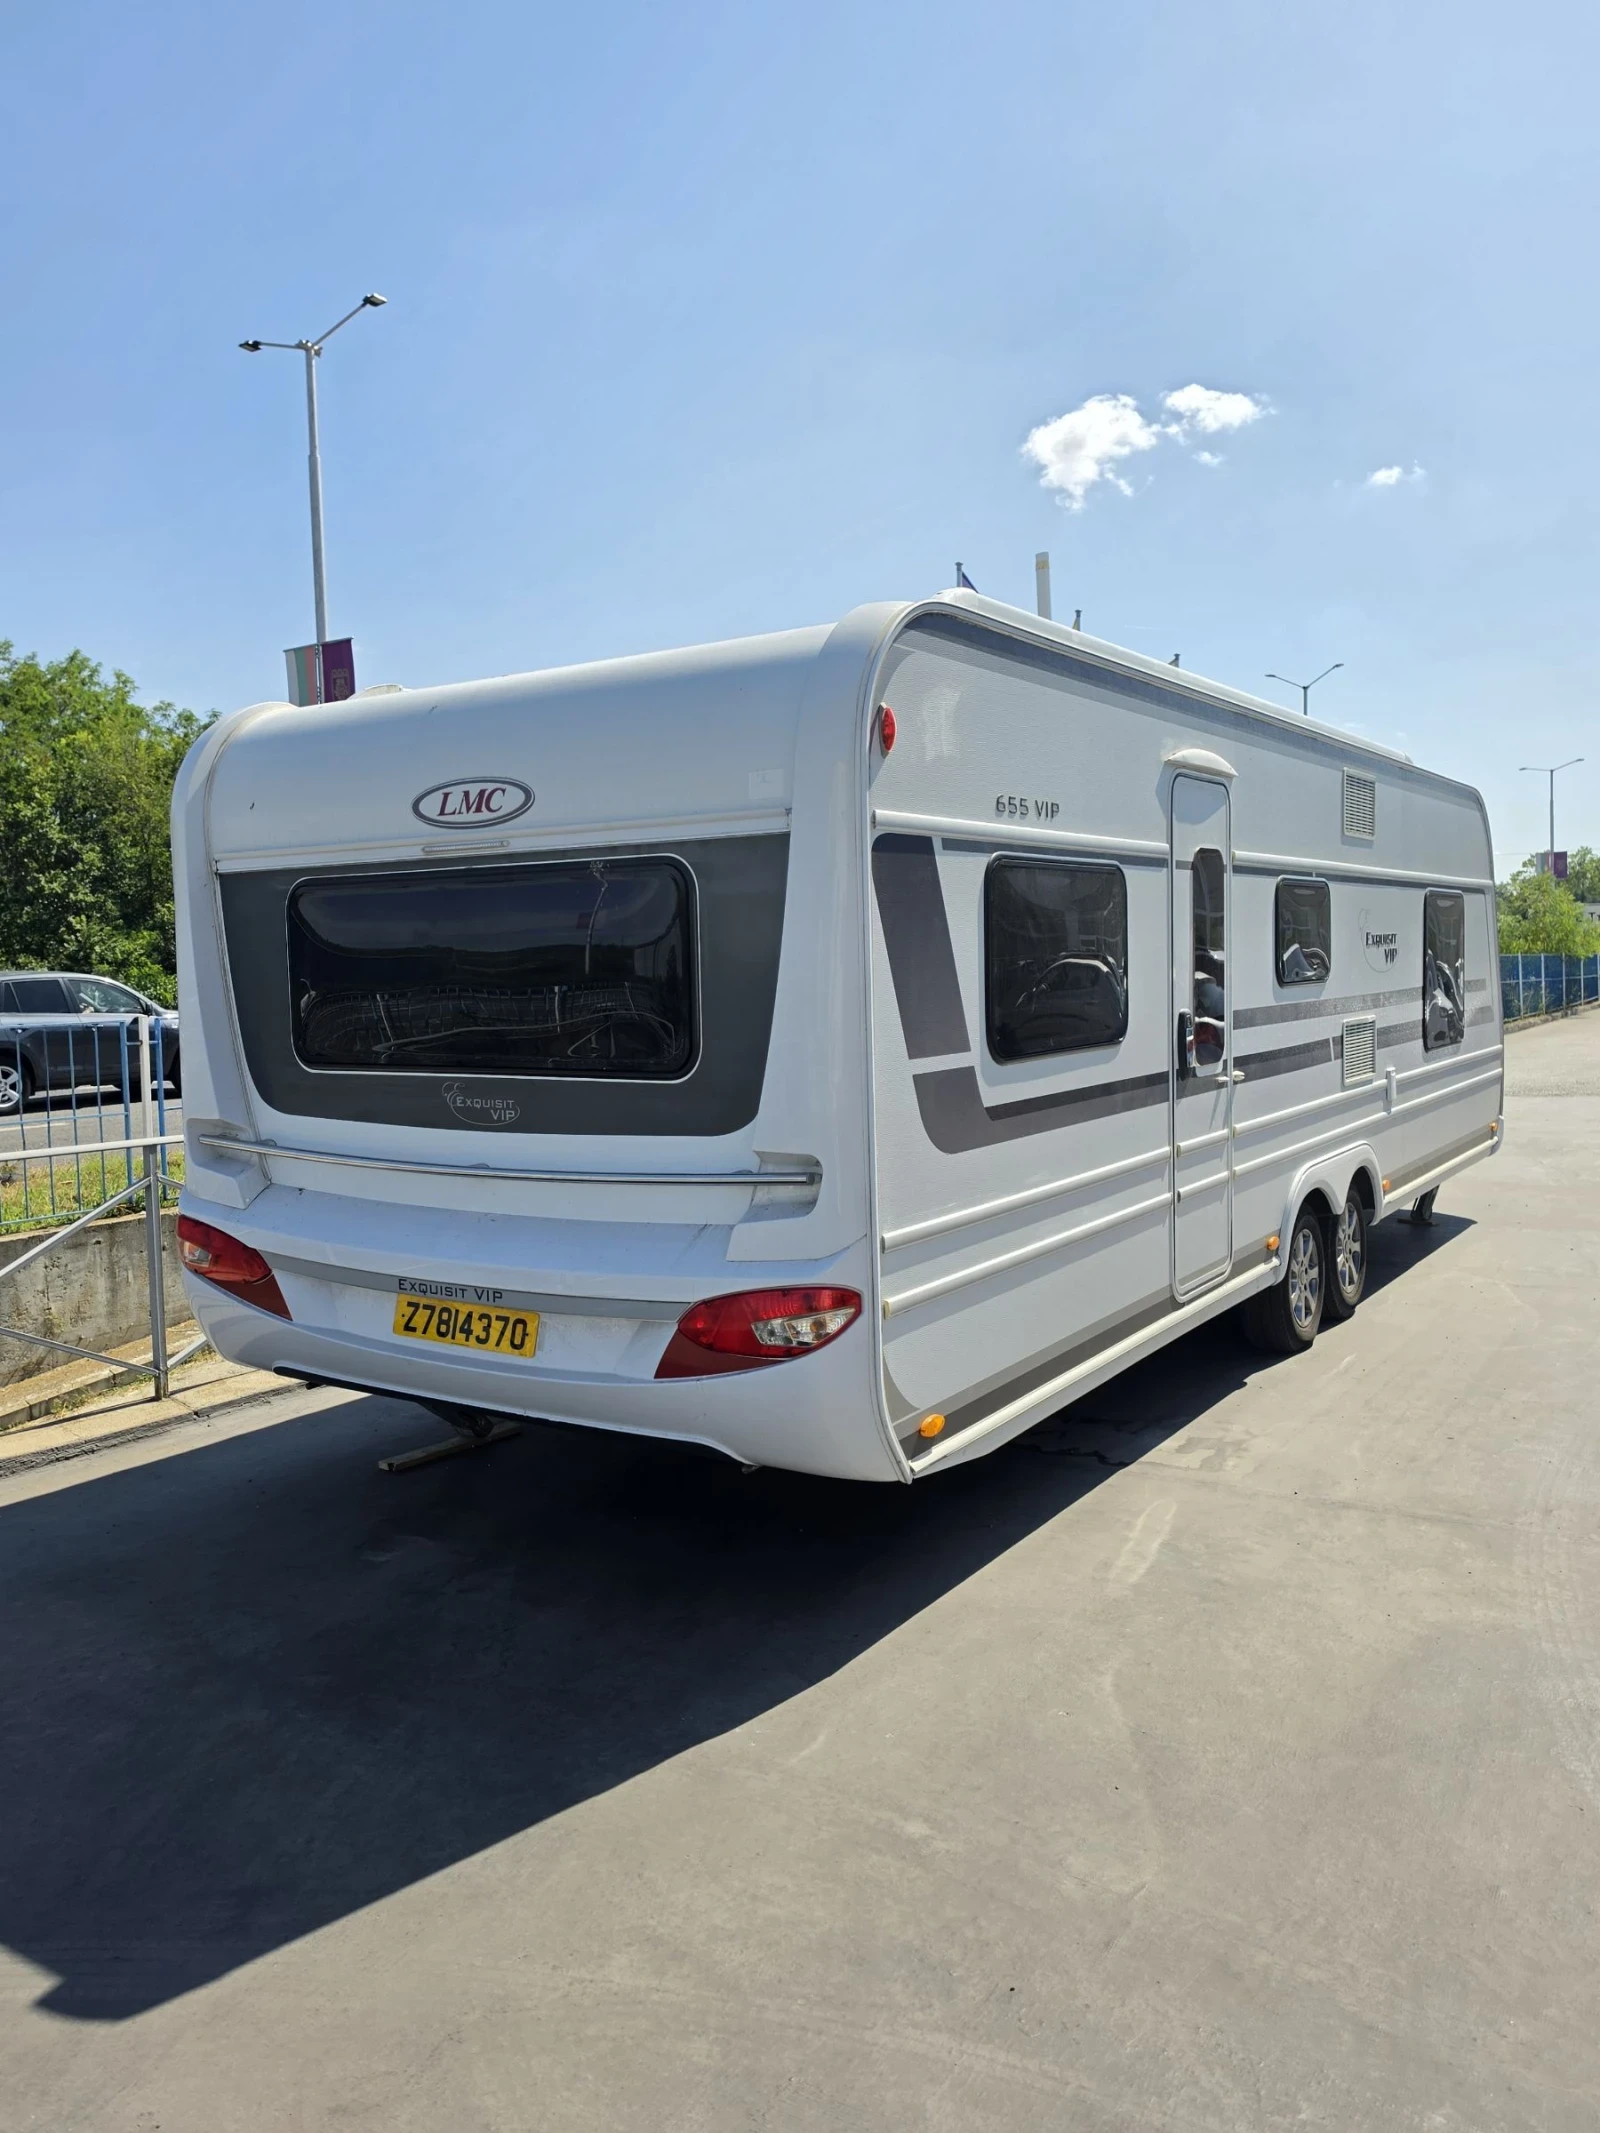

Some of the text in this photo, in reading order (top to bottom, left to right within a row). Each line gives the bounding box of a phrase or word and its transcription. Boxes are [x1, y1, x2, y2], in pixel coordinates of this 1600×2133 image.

[436, 787, 507, 817] LMC
[996, 794, 1060, 819] 655 VIP
[1384, 948, 1398, 964] VIP
[490, 1109, 515, 1121] VIP
[398, 1278, 504, 1303] EXQUISIT VIP
[402, 1300, 528, 1351] Z7814370
